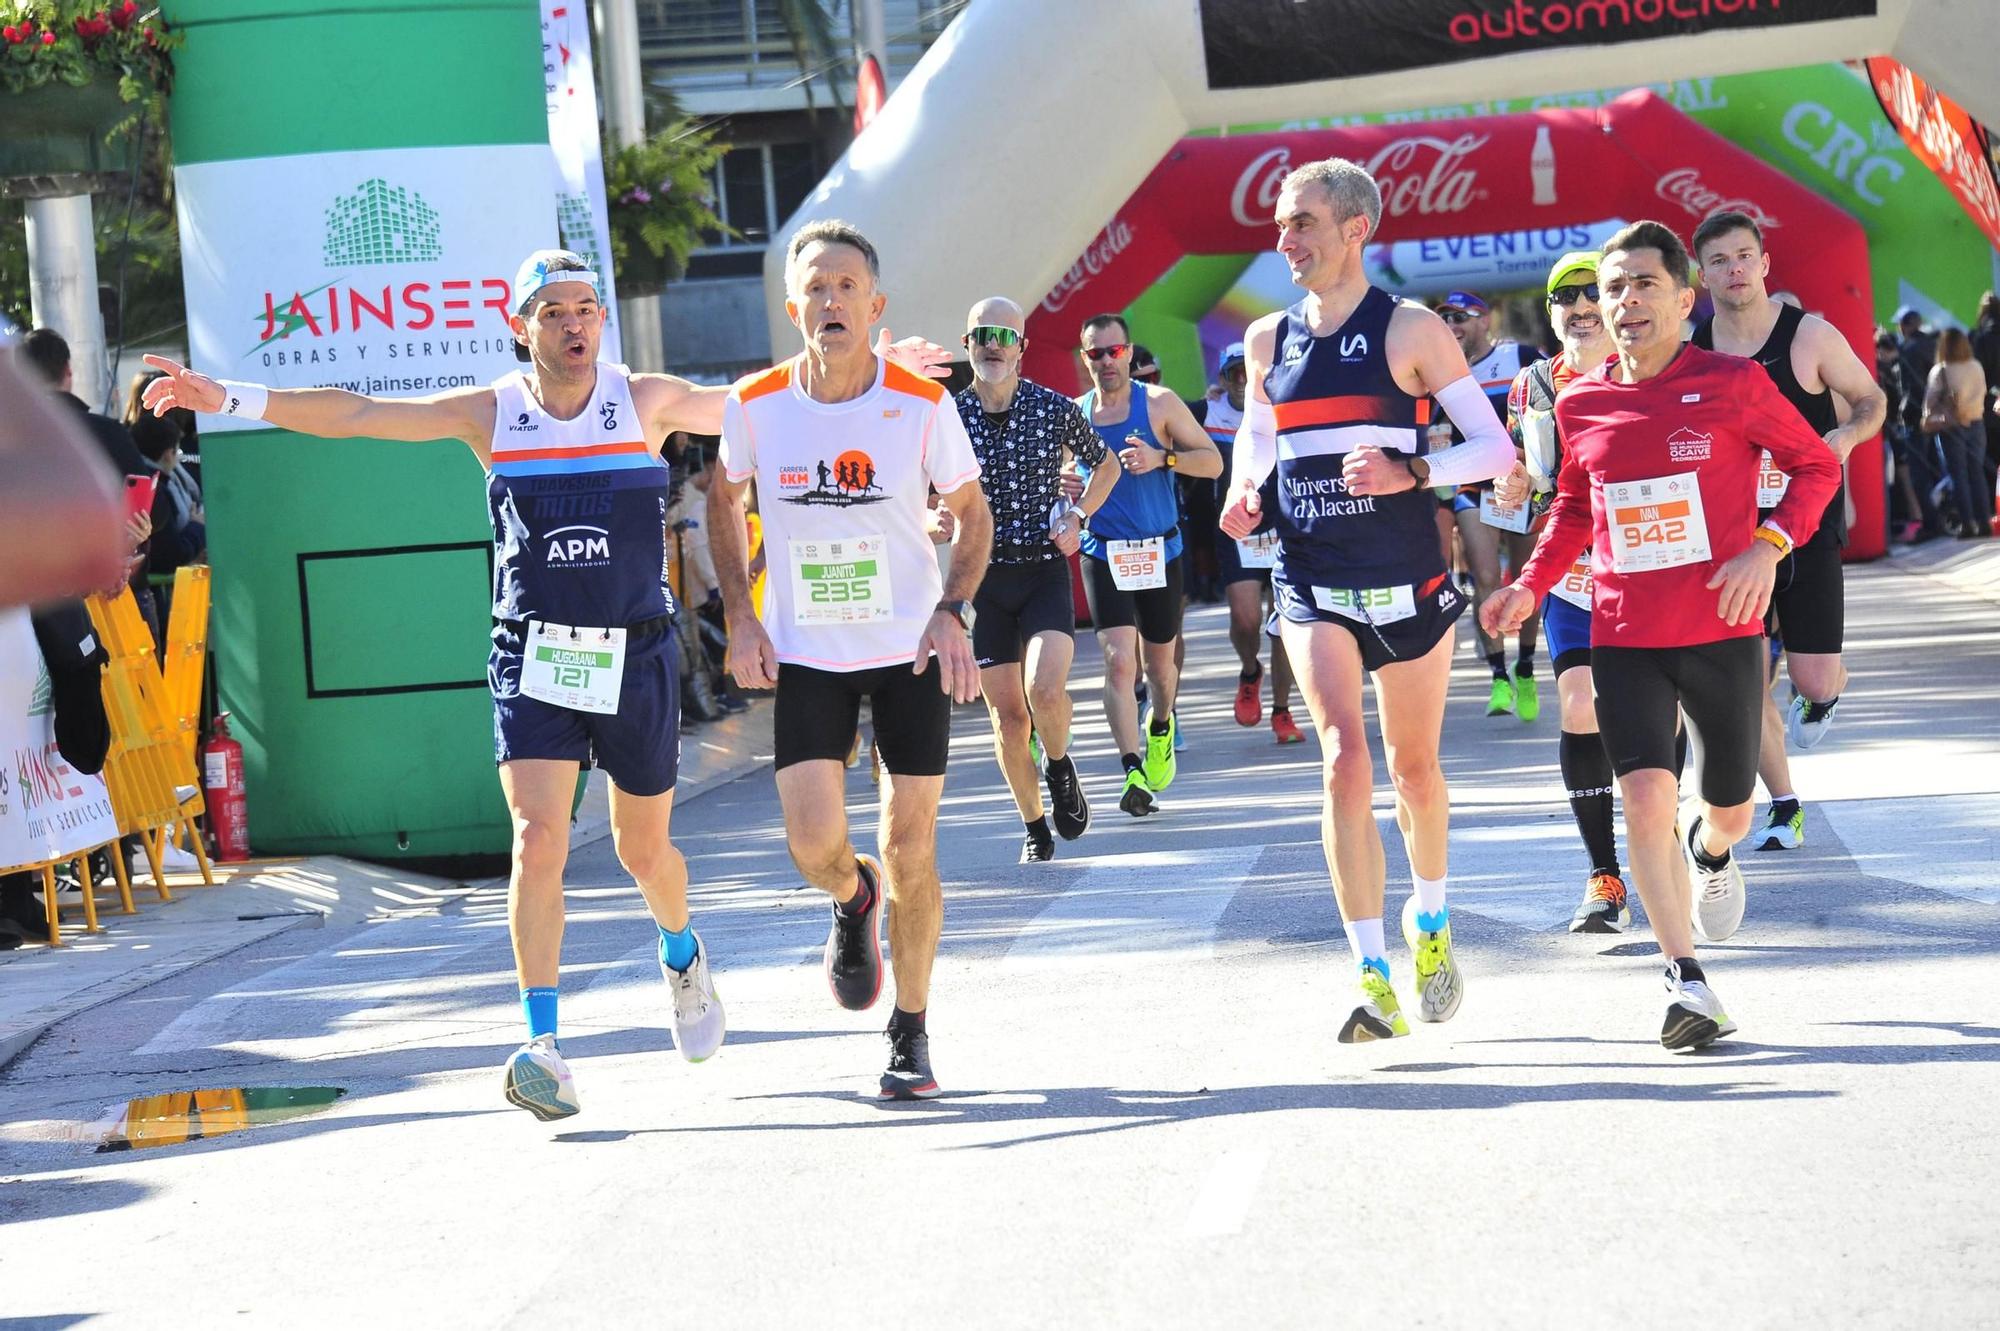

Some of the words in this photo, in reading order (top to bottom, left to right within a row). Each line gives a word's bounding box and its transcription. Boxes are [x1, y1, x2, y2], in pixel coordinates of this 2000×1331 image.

[1782, 100, 1905, 206] CRC
[260, 279, 512, 341] JAINSER
[263, 347, 338, 368] OBRAS
[356, 345, 367, 359] Y
[509, 424, 539, 432] VIATOR
[1669, 447, 1711, 457] OCAIVE
[780, 474, 809, 484] 6KM
[1286, 476, 1348, 497] Univers
[1640, 505, 1660, 522] IVAN
[1624, 520, 1687, 548] 942
[547, 537, 610, 562] APM
[821, 564, 856, 579] JUANITO
[1119, 563, 1154, 577] 999
[811, 580, 872, 602] 235
[553, 666, 591, 688] 121
